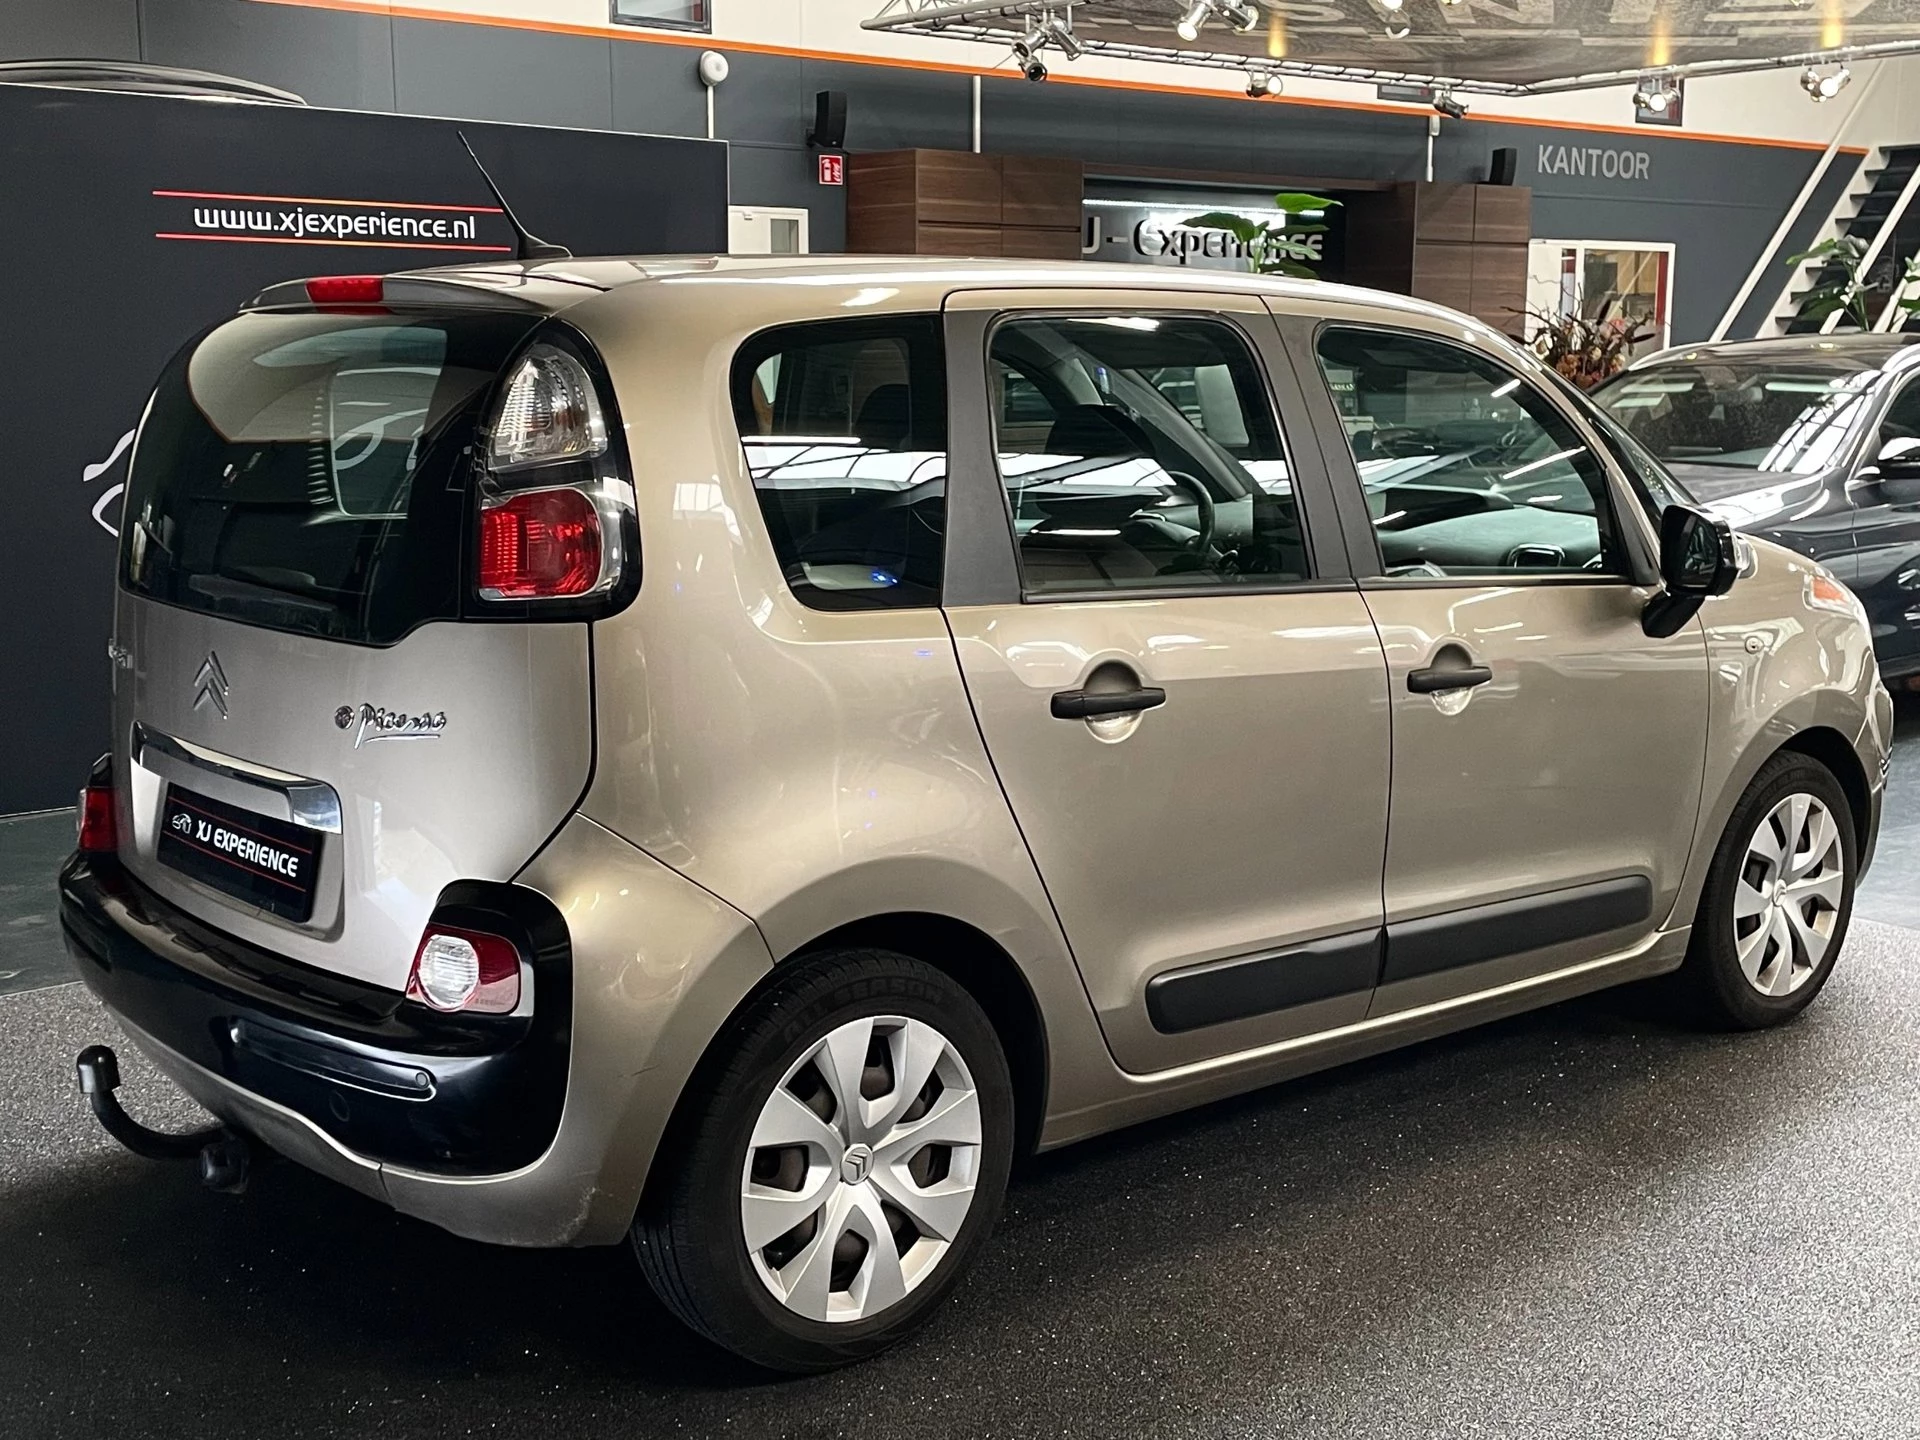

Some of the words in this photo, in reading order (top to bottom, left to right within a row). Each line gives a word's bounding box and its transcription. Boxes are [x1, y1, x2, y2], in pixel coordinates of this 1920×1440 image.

[1538, 144, 1650, 180] KANTOOR
[193, 206, 476, 240] www.xjexperience.nl
[196, 820, 212, 842] XJ
[213, 828, 299, 878] EXPERIENCE
